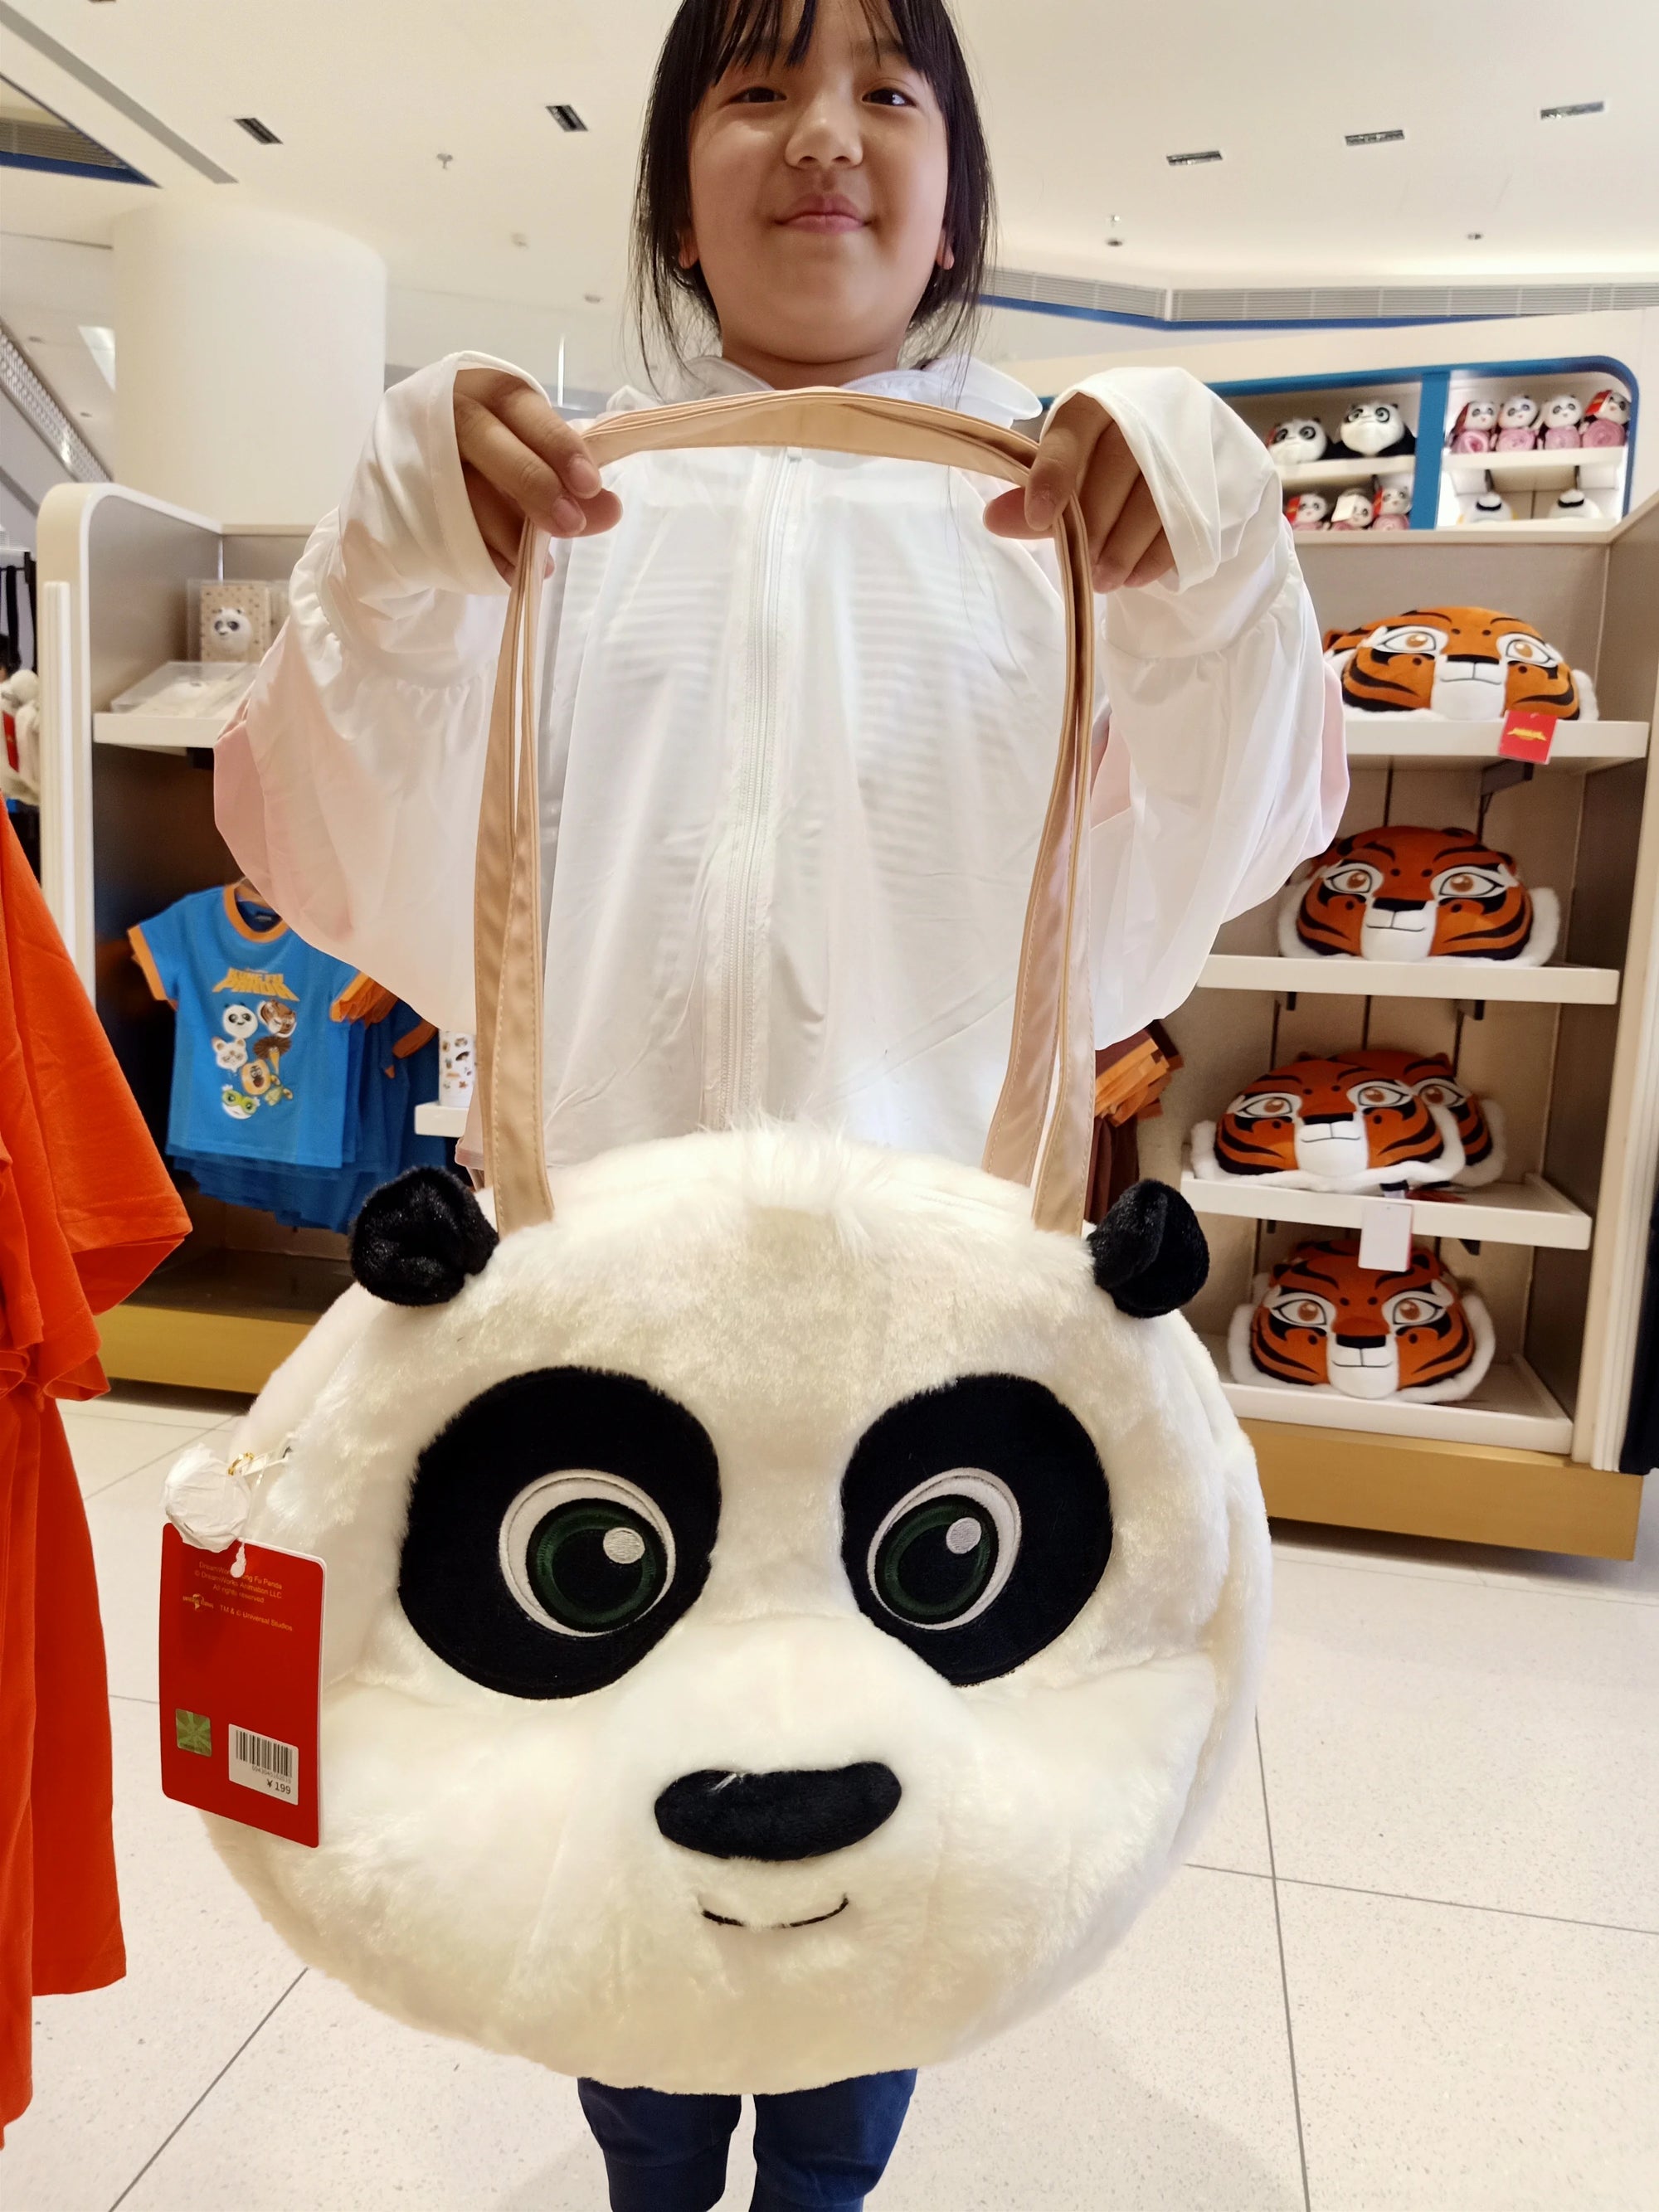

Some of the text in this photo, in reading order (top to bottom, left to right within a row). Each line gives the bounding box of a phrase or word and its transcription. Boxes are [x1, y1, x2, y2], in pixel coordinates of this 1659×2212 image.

[199, 1561, 231, 1575] DreamWor
[263, 1577, 283, 1590] Panda
[202, 1572, 238, 1587] DreamWorks
[240, 1582, 268, 1594] Animation
[270, 1591, 282, 1599] LLC
[220, 1604, 230, 1613] TM
[242, 1611, 270, 1626] Universal
[270, 1619, 293, 1631] Studios
[275, 1782, 291, 1795] 199
